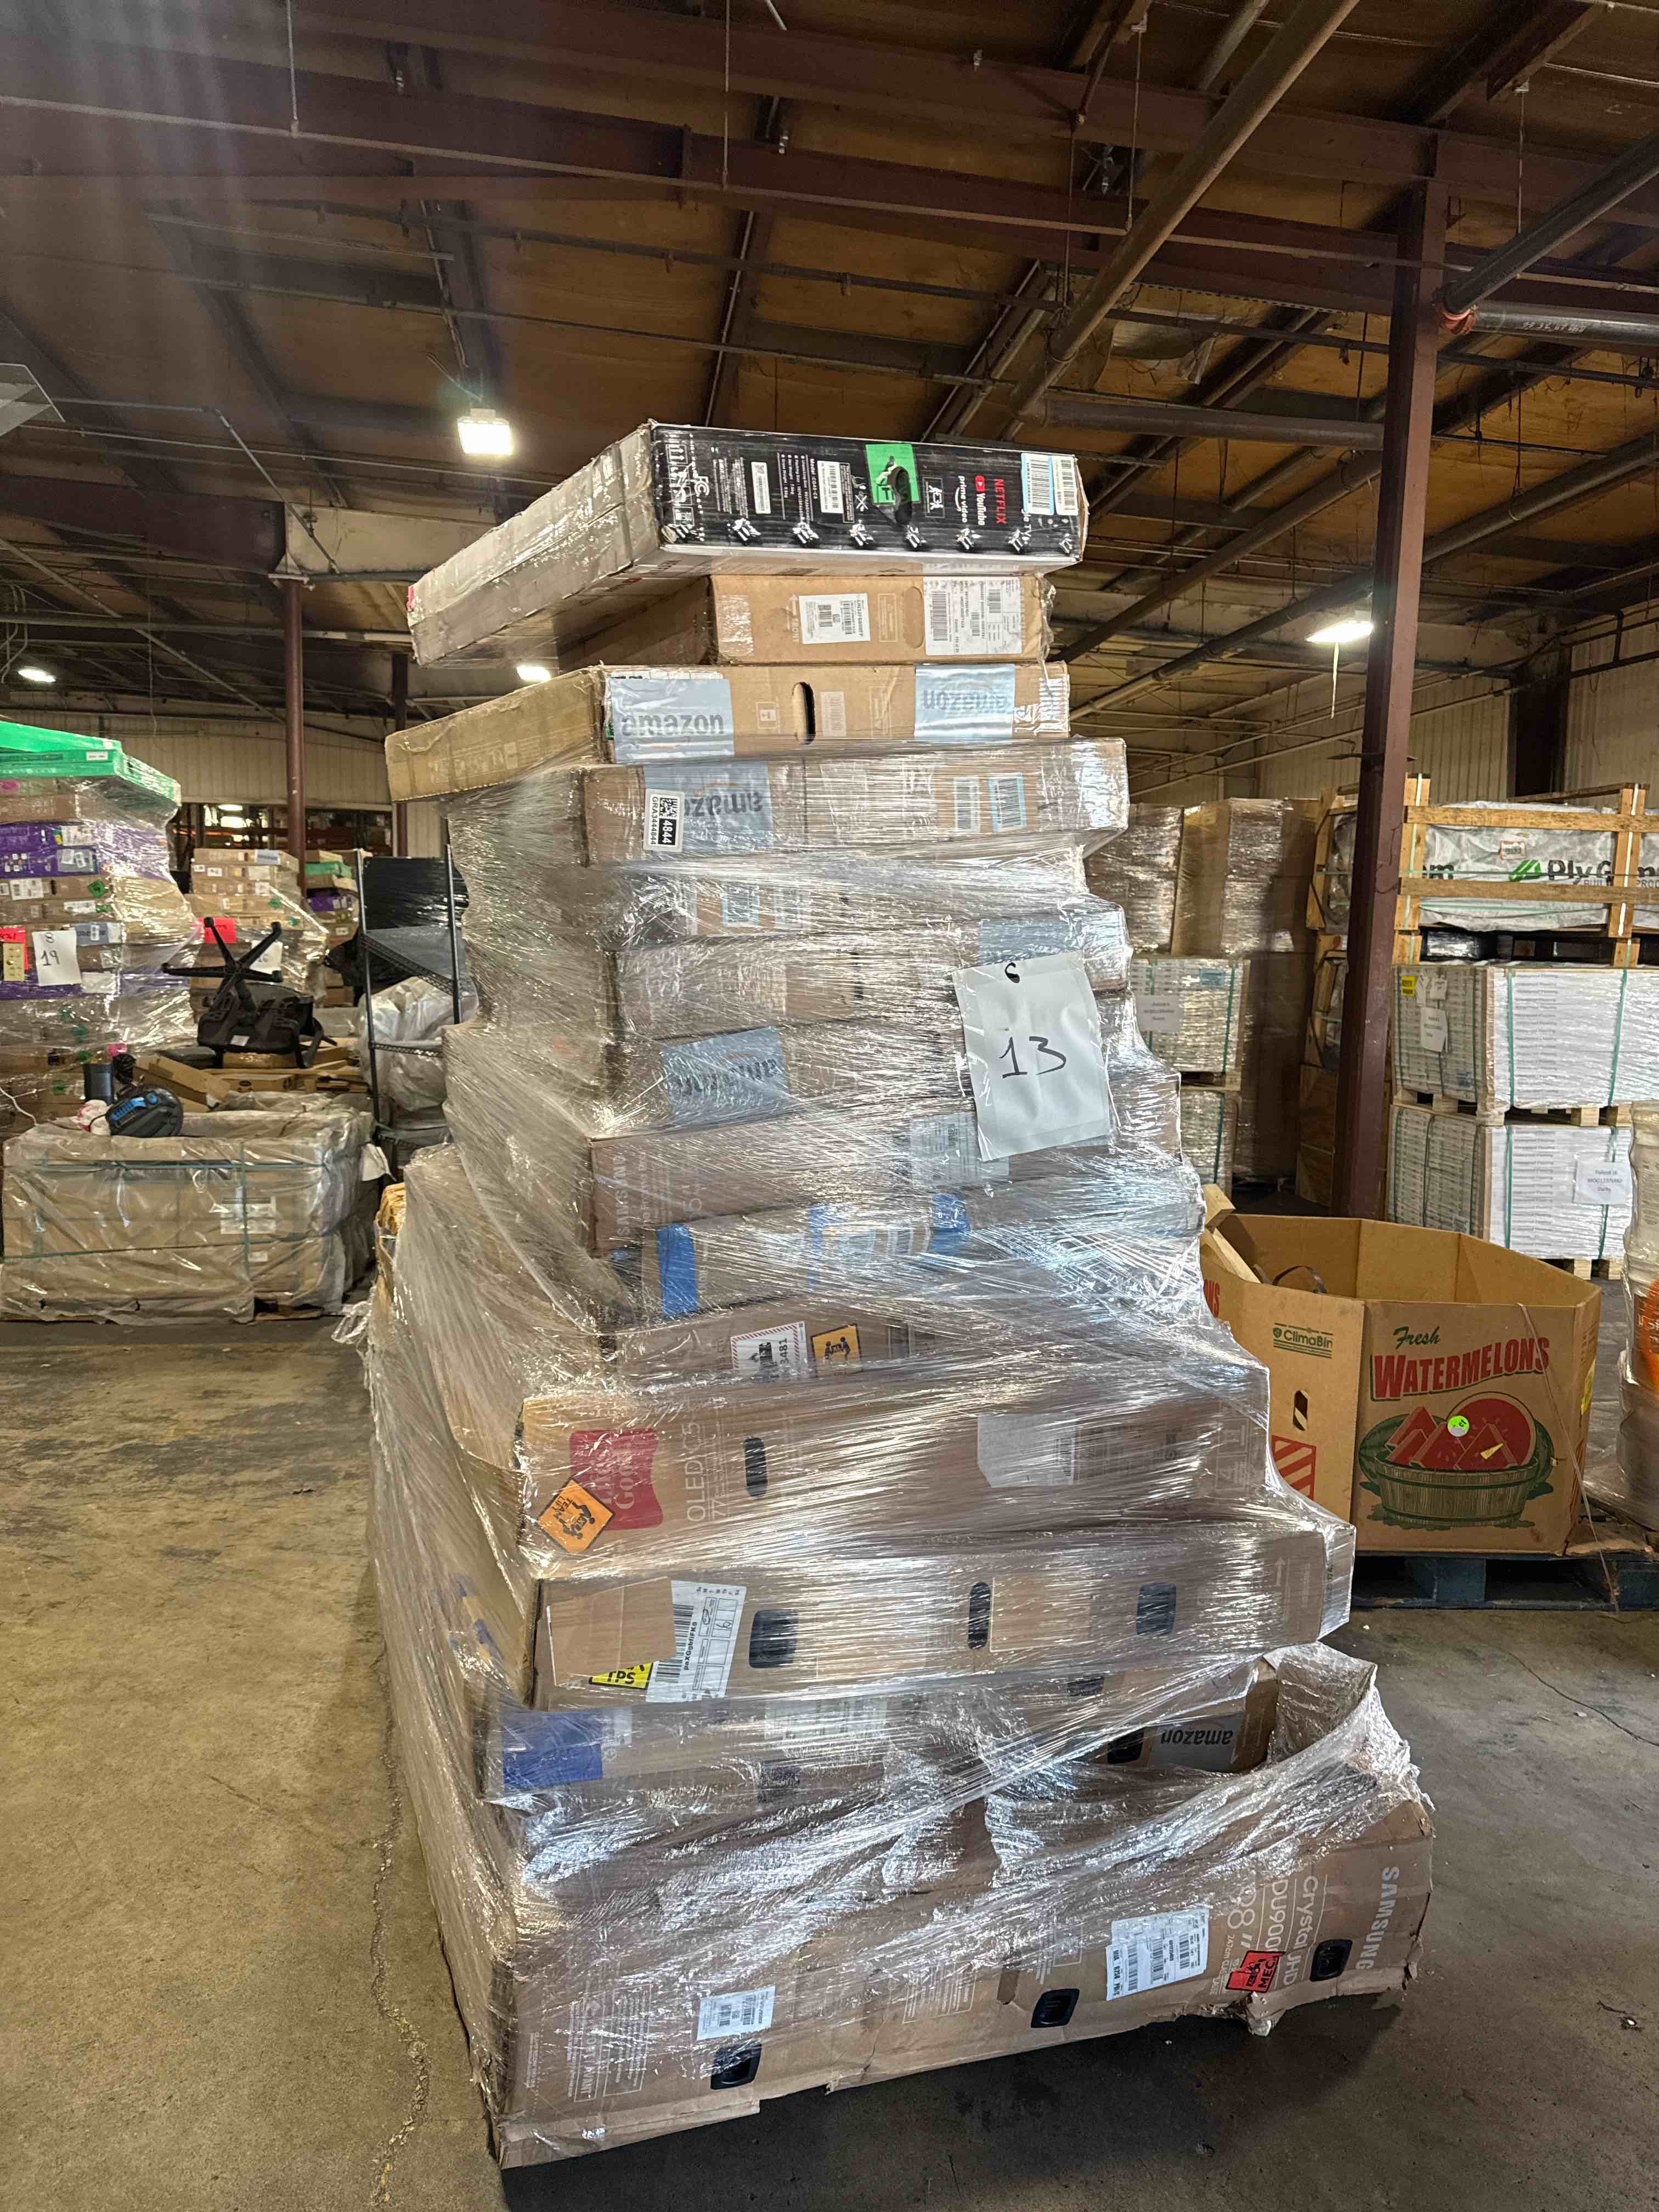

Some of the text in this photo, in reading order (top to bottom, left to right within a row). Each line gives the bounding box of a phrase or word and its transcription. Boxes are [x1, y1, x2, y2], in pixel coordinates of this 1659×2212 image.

[958, 476, 967, 499] prime
[977, 493, 987, 526] YouTube
[994, 479, 1006, 524] NETFLIX
[923, 689, 1008, 711] amazon
[621, 714, 725, 736] amazon
[685, 792, 763, 817] amaz
[650, 797, 658, 845] GRA3444844
[661, 820, 673, 844] 4844
[1547, 860, 1593, 880] Ply
[41, 950, 60, 966] 19
[999, 1036, 1066, 1079] 13
[1284, 1329, 1333, 1349] ClimaBin
[1393, 1326, 1441, 1350] Fresh
[778, 1338, 789, 1365] 3481
[1374, 1337, 1550, 1398] WATERMELONS
[684, 1459, 707, 1522] OLED
[1160, 1729, 1234, 1746] amazon
[1292, 1875, 1318, 1950] Crystal
[1355, 1866, 1401, 1970] SAMSUNG
[1223, 1934, 1234, 1959] 247cm
